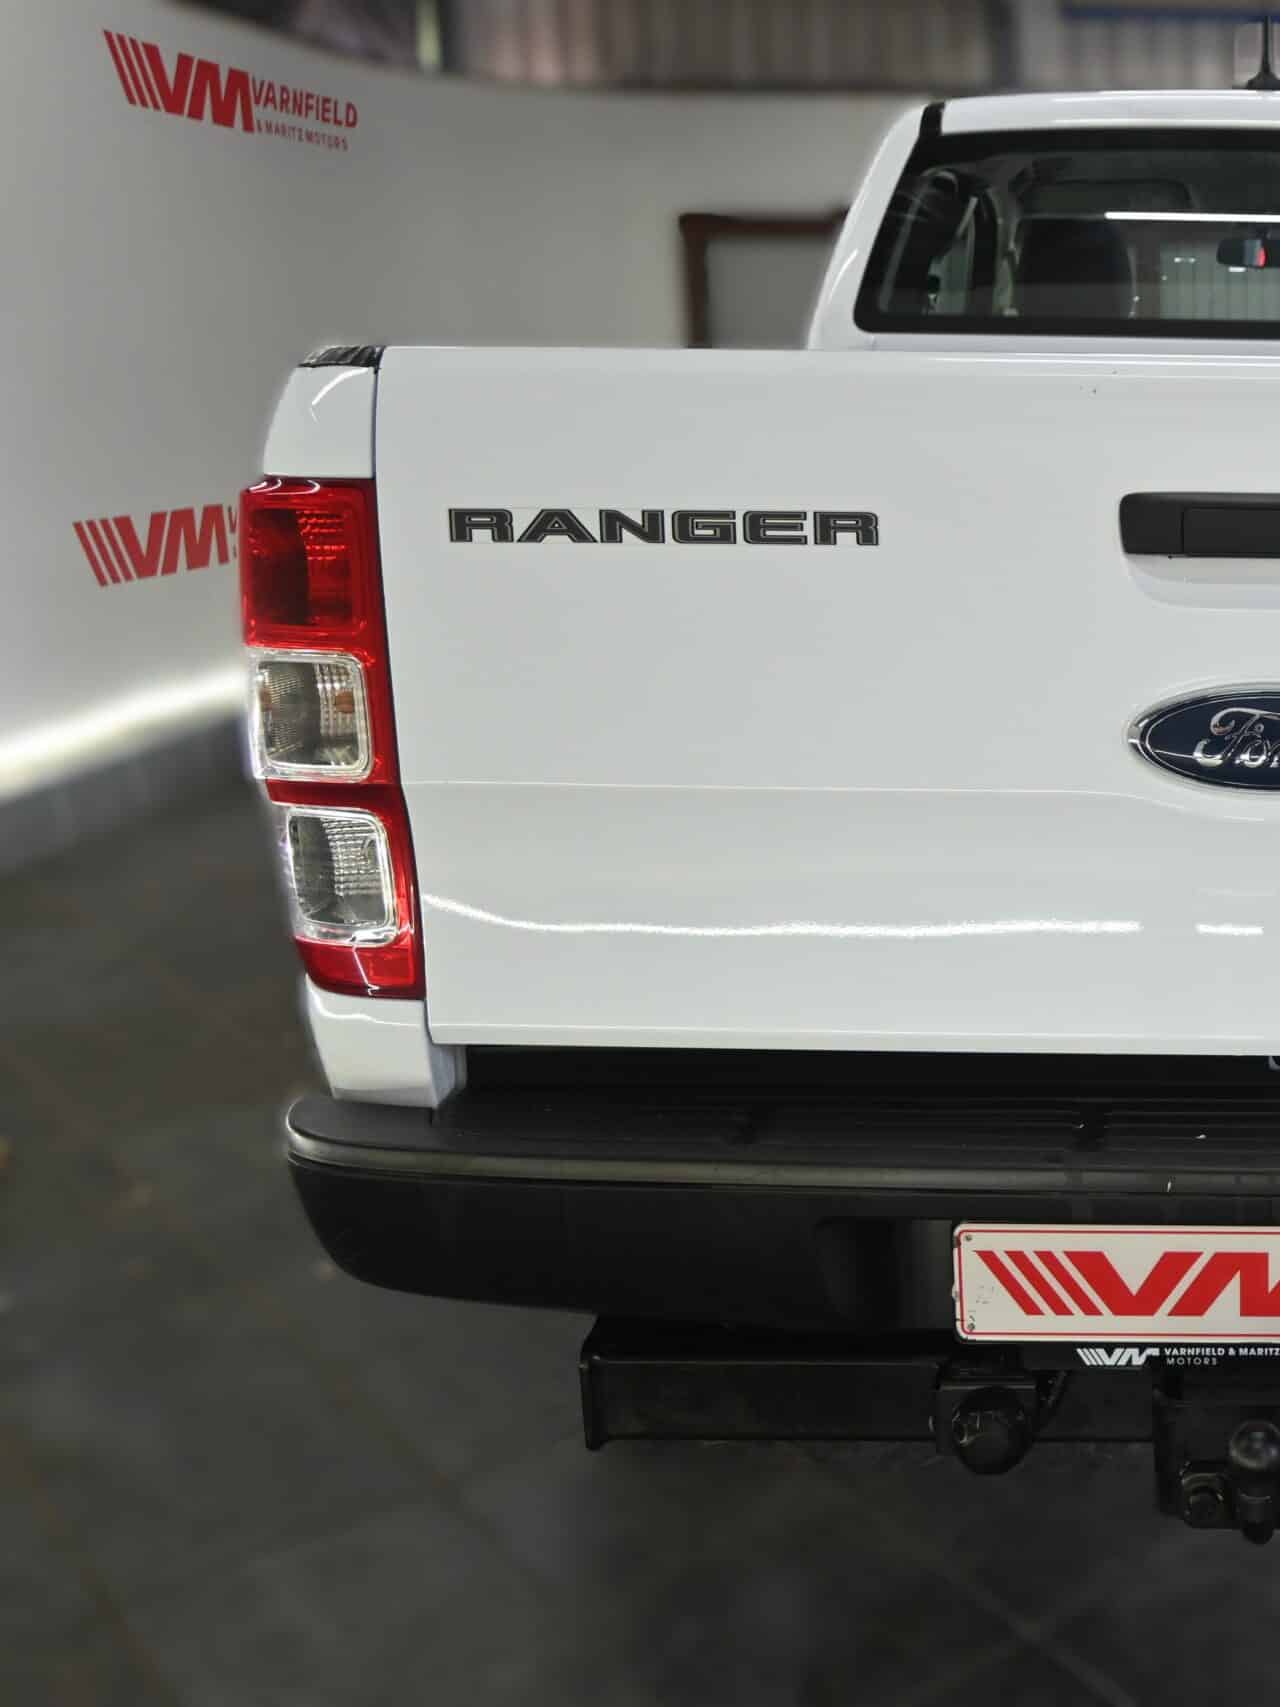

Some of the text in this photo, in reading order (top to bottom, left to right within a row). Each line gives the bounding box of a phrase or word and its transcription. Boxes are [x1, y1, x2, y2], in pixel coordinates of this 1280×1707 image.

[252, 76, 358, 128] VARNFIELD
[448, 508, 880, 546] RANGER
[1164, 1347, 1280, 1357] VARNFIELD & MARITZ
[1166, 1357, 1217, 1366] MOTORS
